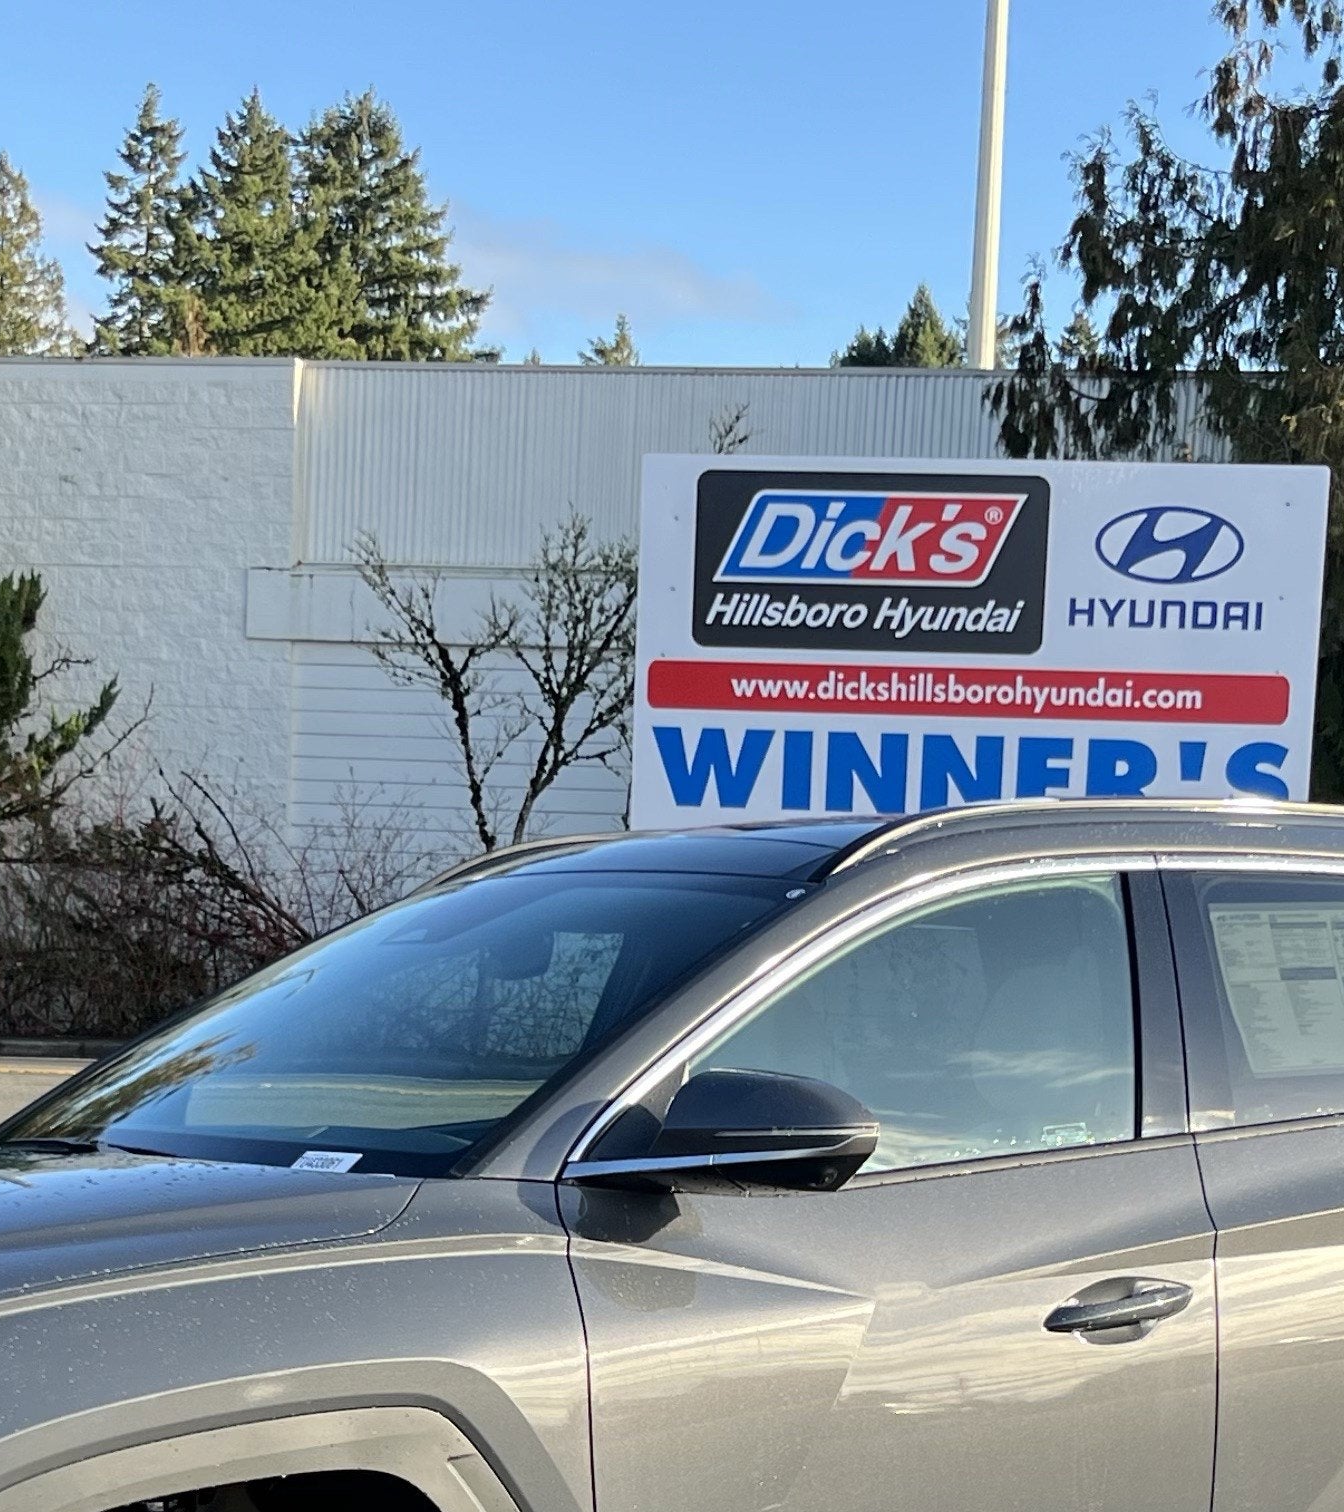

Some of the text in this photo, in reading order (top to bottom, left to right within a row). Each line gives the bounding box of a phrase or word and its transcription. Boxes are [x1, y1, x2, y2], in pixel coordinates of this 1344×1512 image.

[705, 592, 1026, 638] Hillsboro Hyundai
[1068, 597, 1264, 631] HYUNDAI
[730, 670, 1203, 714] www.dickshillsborohyundai.com
[652, 724, 1291, 815] WINNER'S
